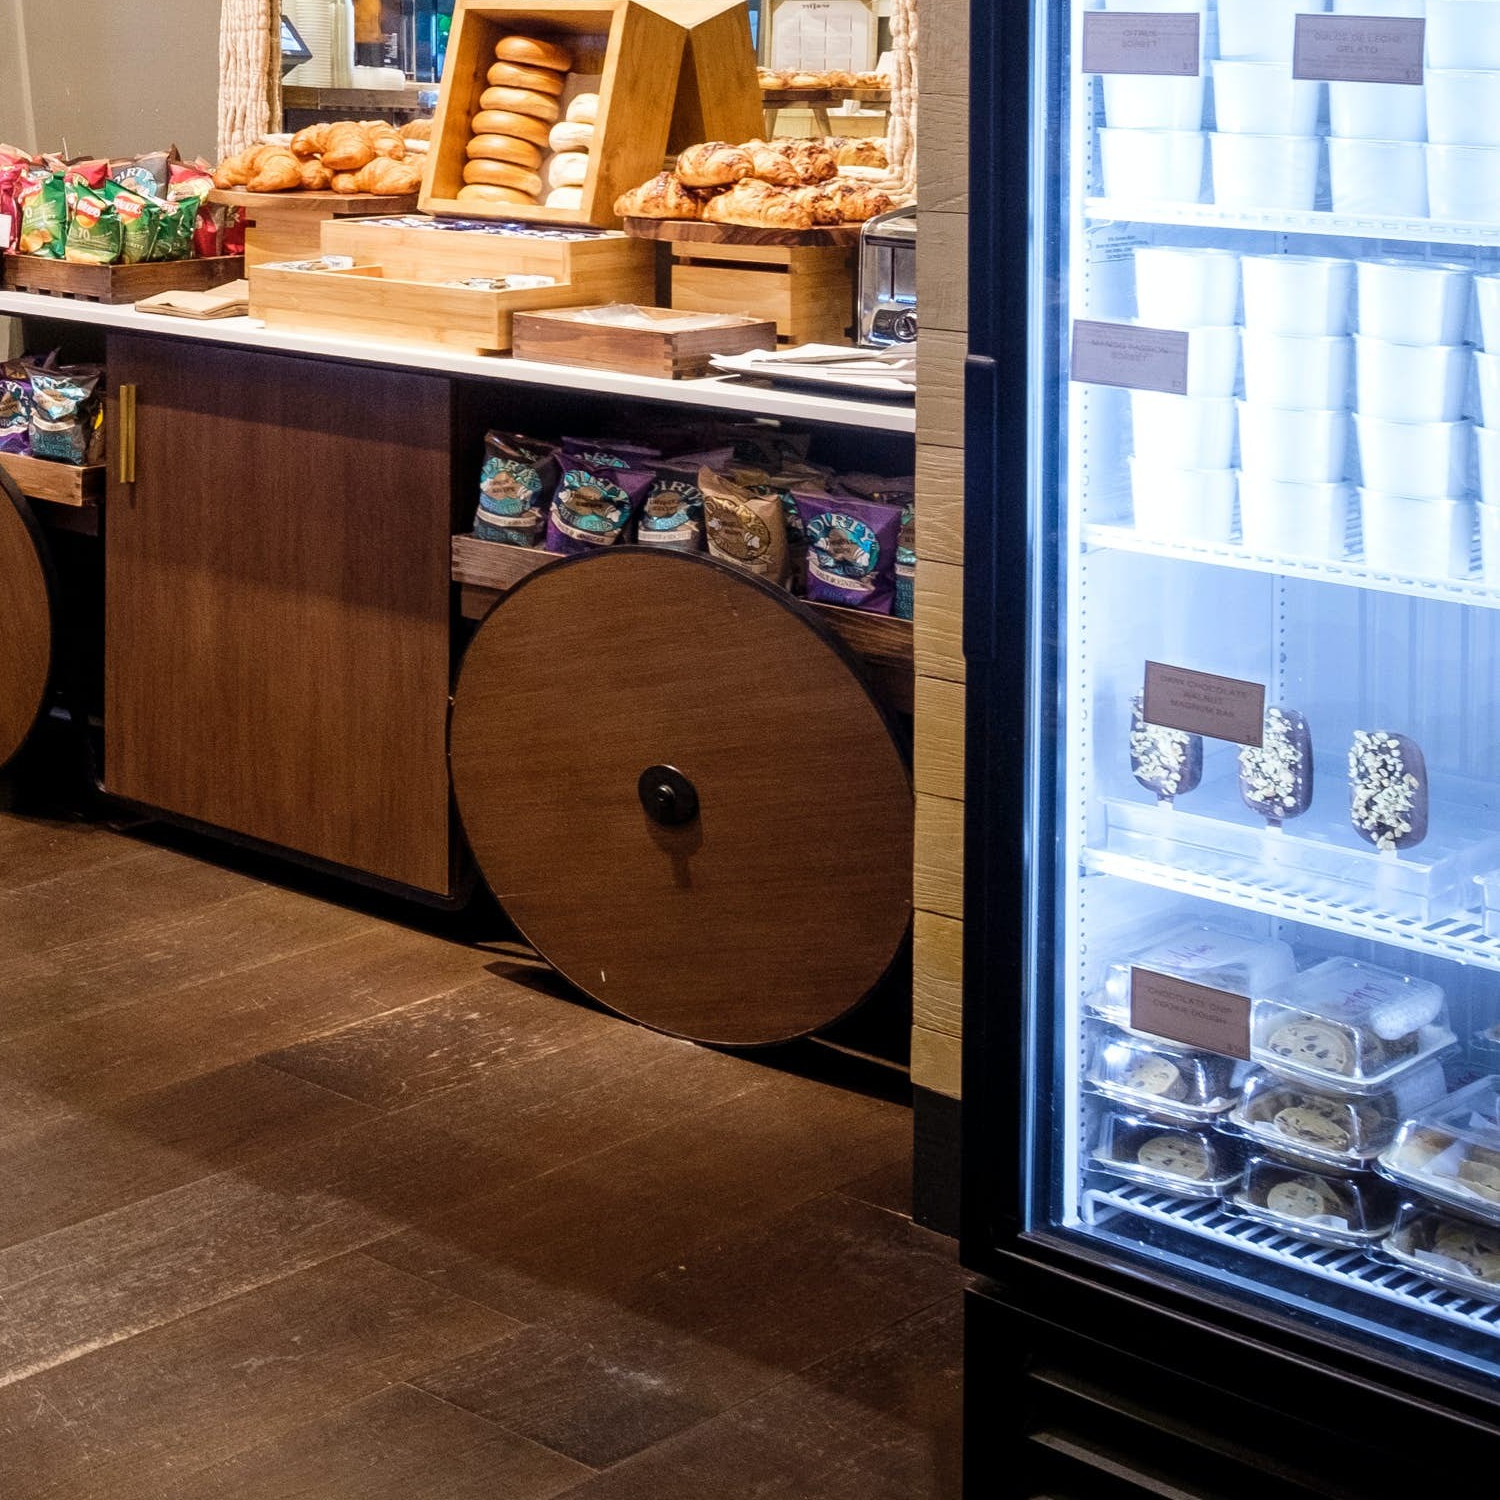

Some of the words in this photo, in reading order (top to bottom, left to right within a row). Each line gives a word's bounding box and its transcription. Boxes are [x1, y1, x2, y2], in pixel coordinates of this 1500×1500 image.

[1336, 45, 1379, 54] GELATO
[807, 513, 879, 543] DIRTY
[1188, 681, 1247, 699] CHOCOLATE
